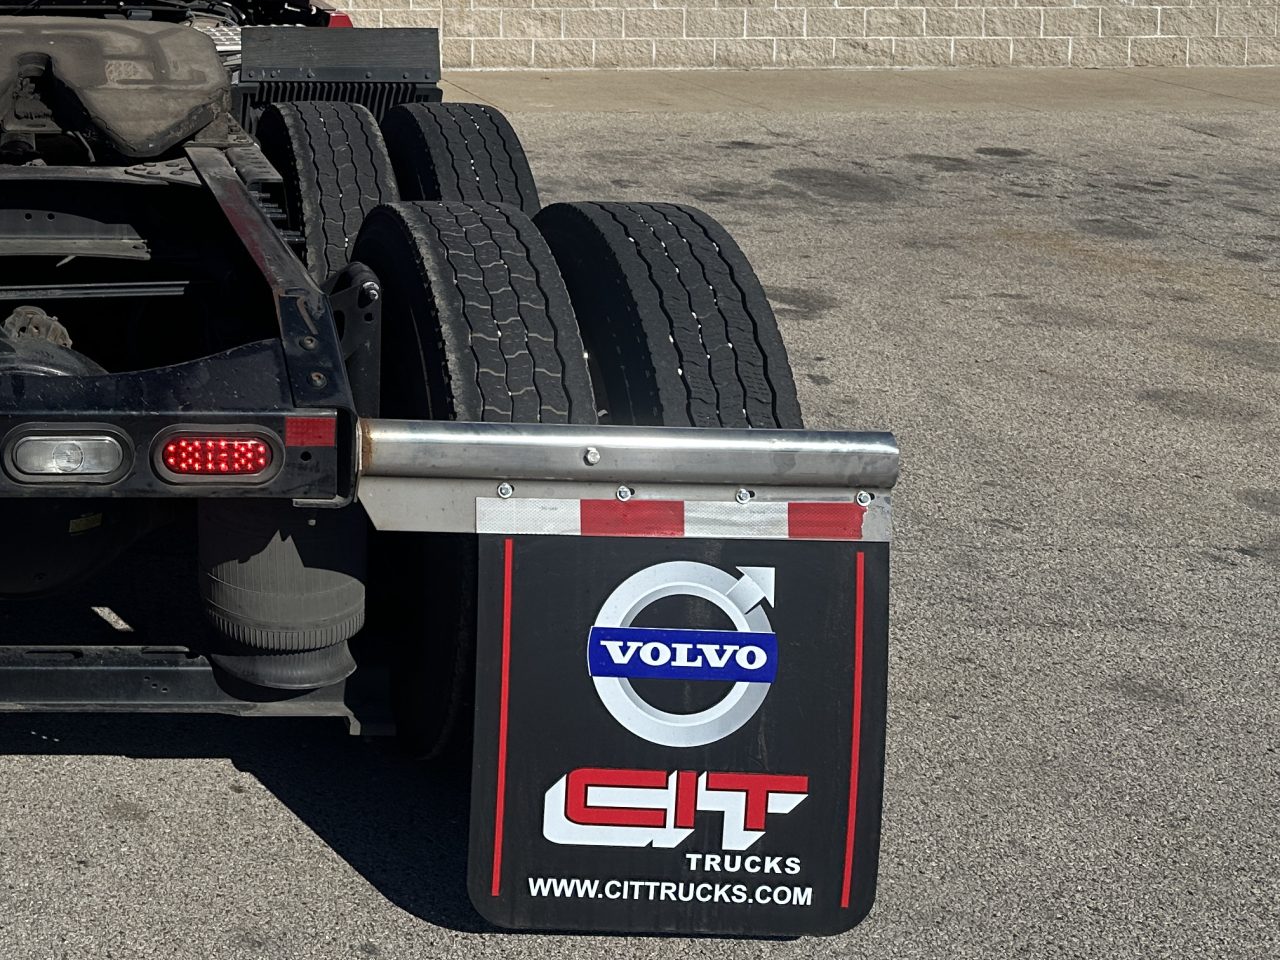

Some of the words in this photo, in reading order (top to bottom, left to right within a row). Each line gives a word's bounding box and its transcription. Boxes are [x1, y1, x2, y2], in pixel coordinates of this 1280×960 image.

[600, 639, 768, 670] VOLVO
[564, 767, 810, 831] CIT
[685, 852, 802, 875] TRUCKS
[528, 877, 813, 906] WWW.CITTRUCKS.COM
